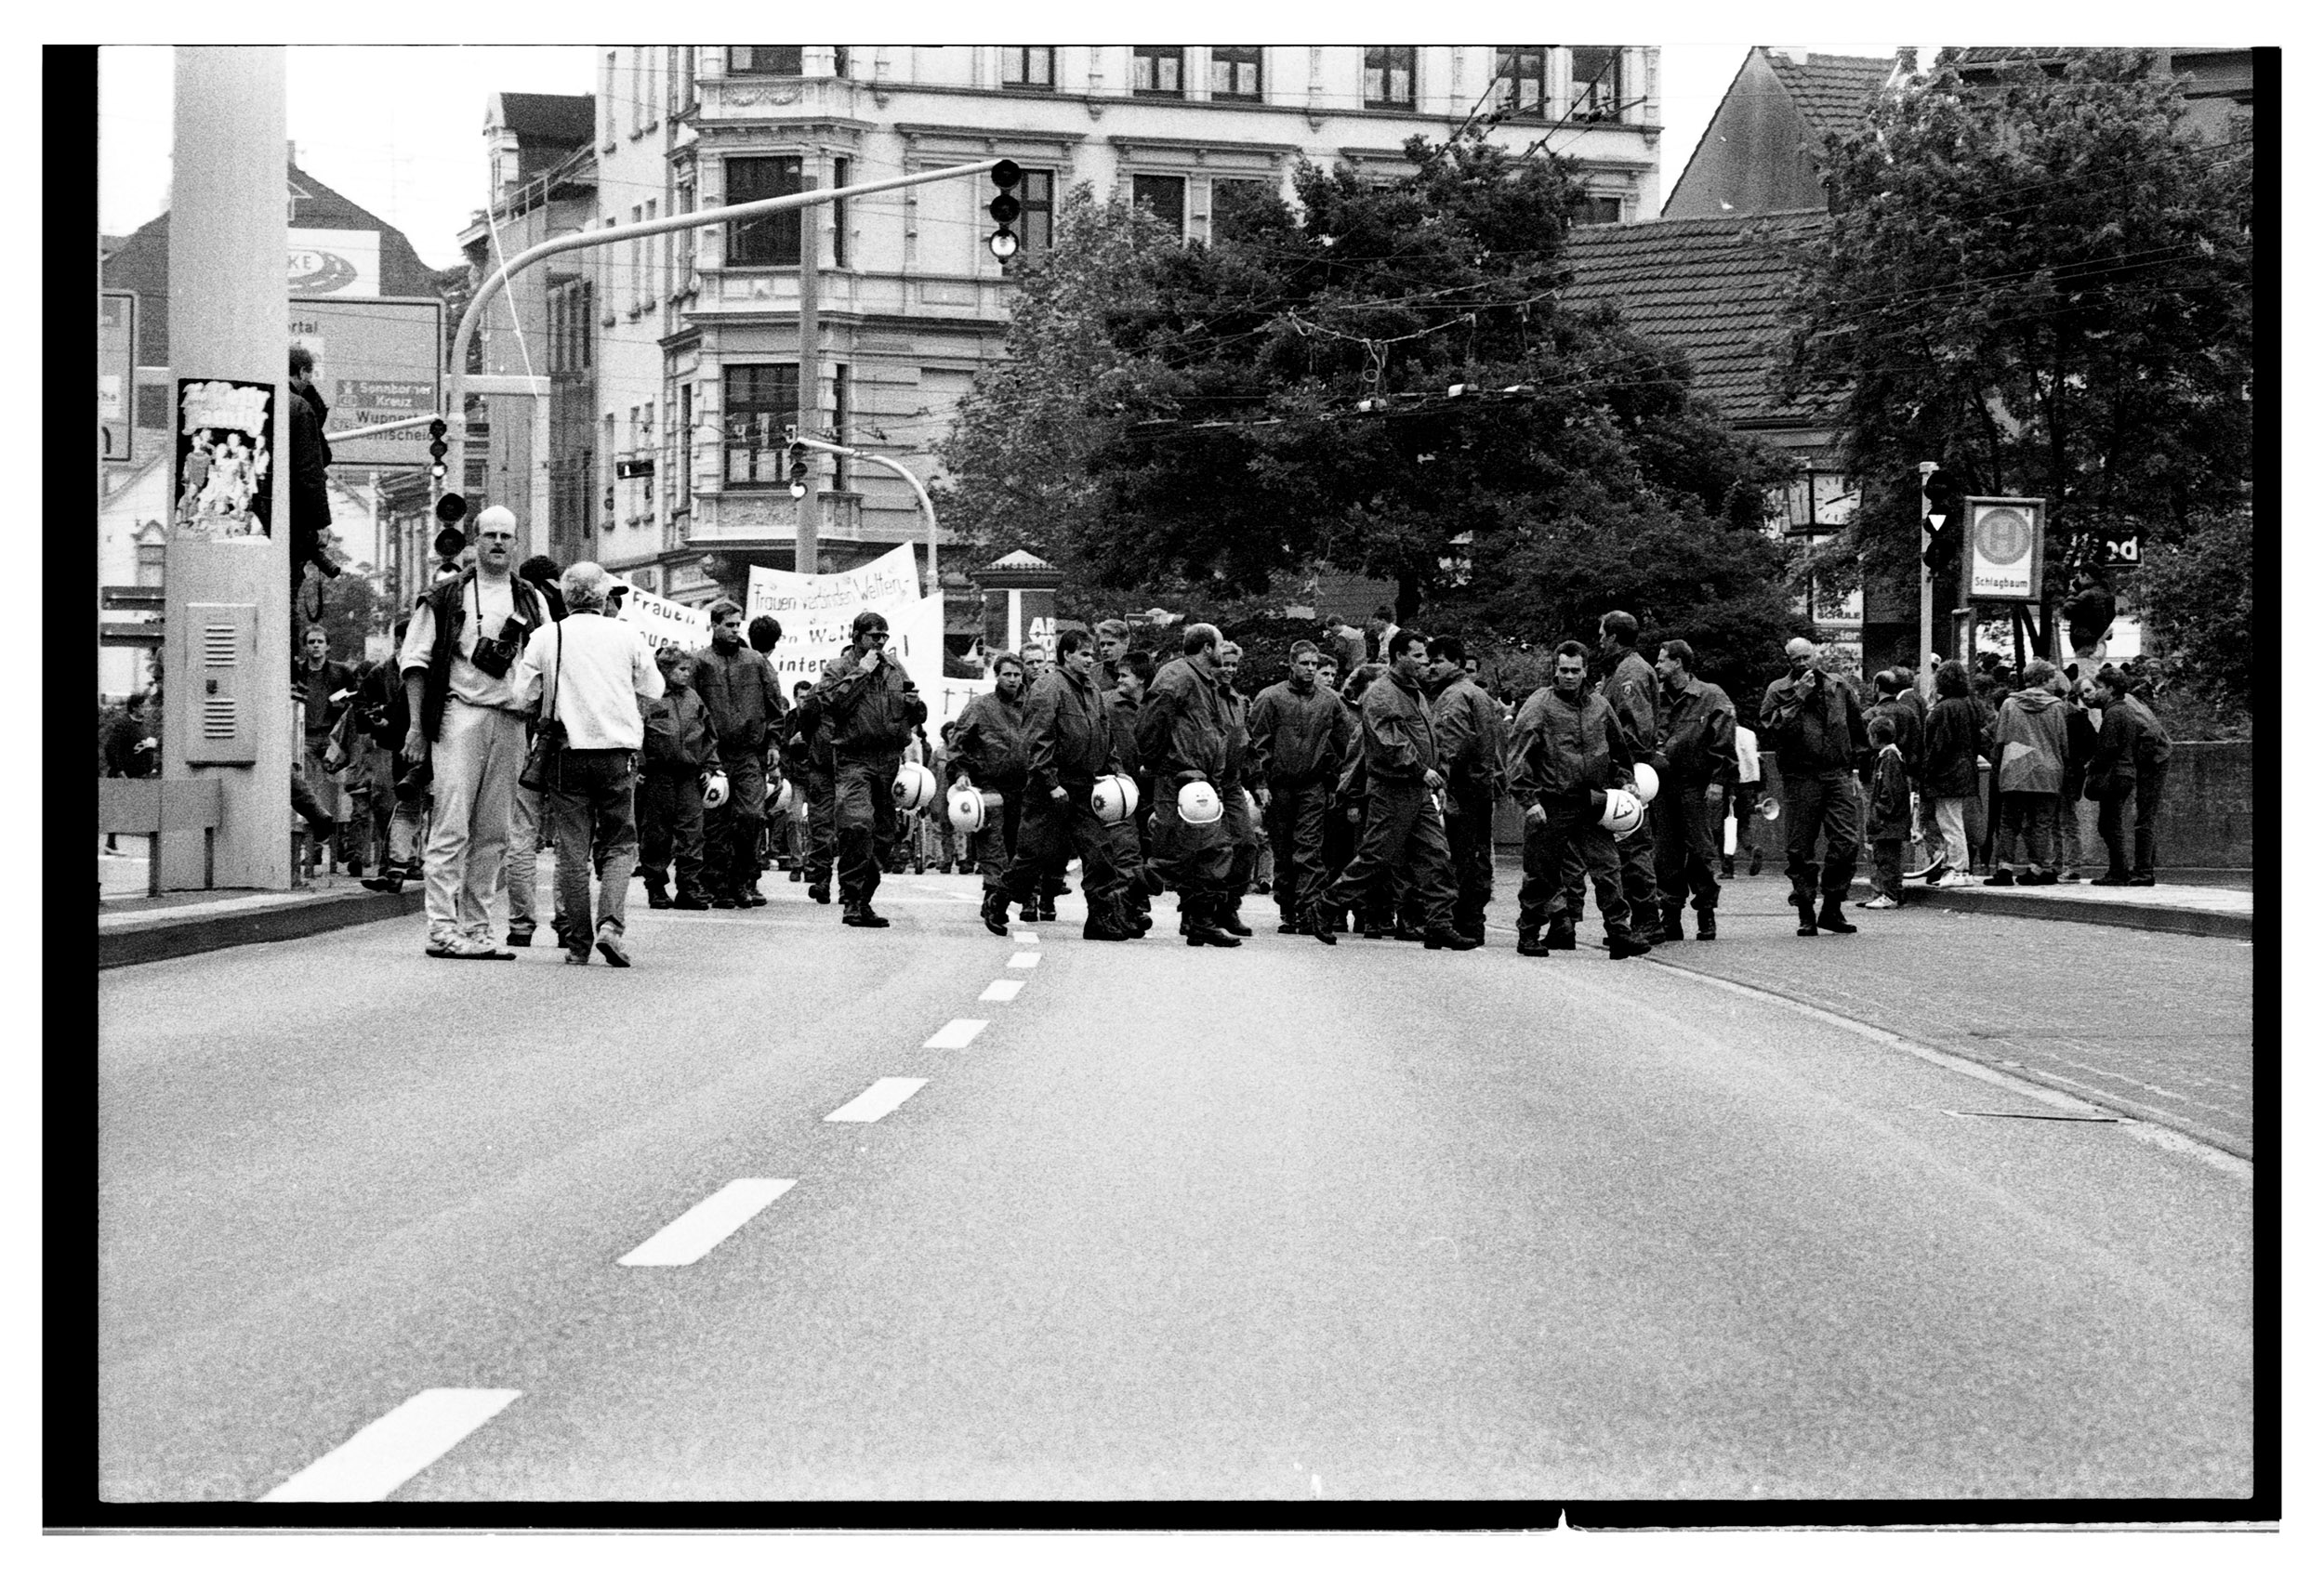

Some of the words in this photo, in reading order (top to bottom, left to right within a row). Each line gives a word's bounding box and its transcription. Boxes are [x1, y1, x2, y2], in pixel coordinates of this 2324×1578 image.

[288, 322, 318, 333] rtal
[376, 396, 412, 407] Kreuz
[1974, 576, 2028, 590] Schlagbaum
